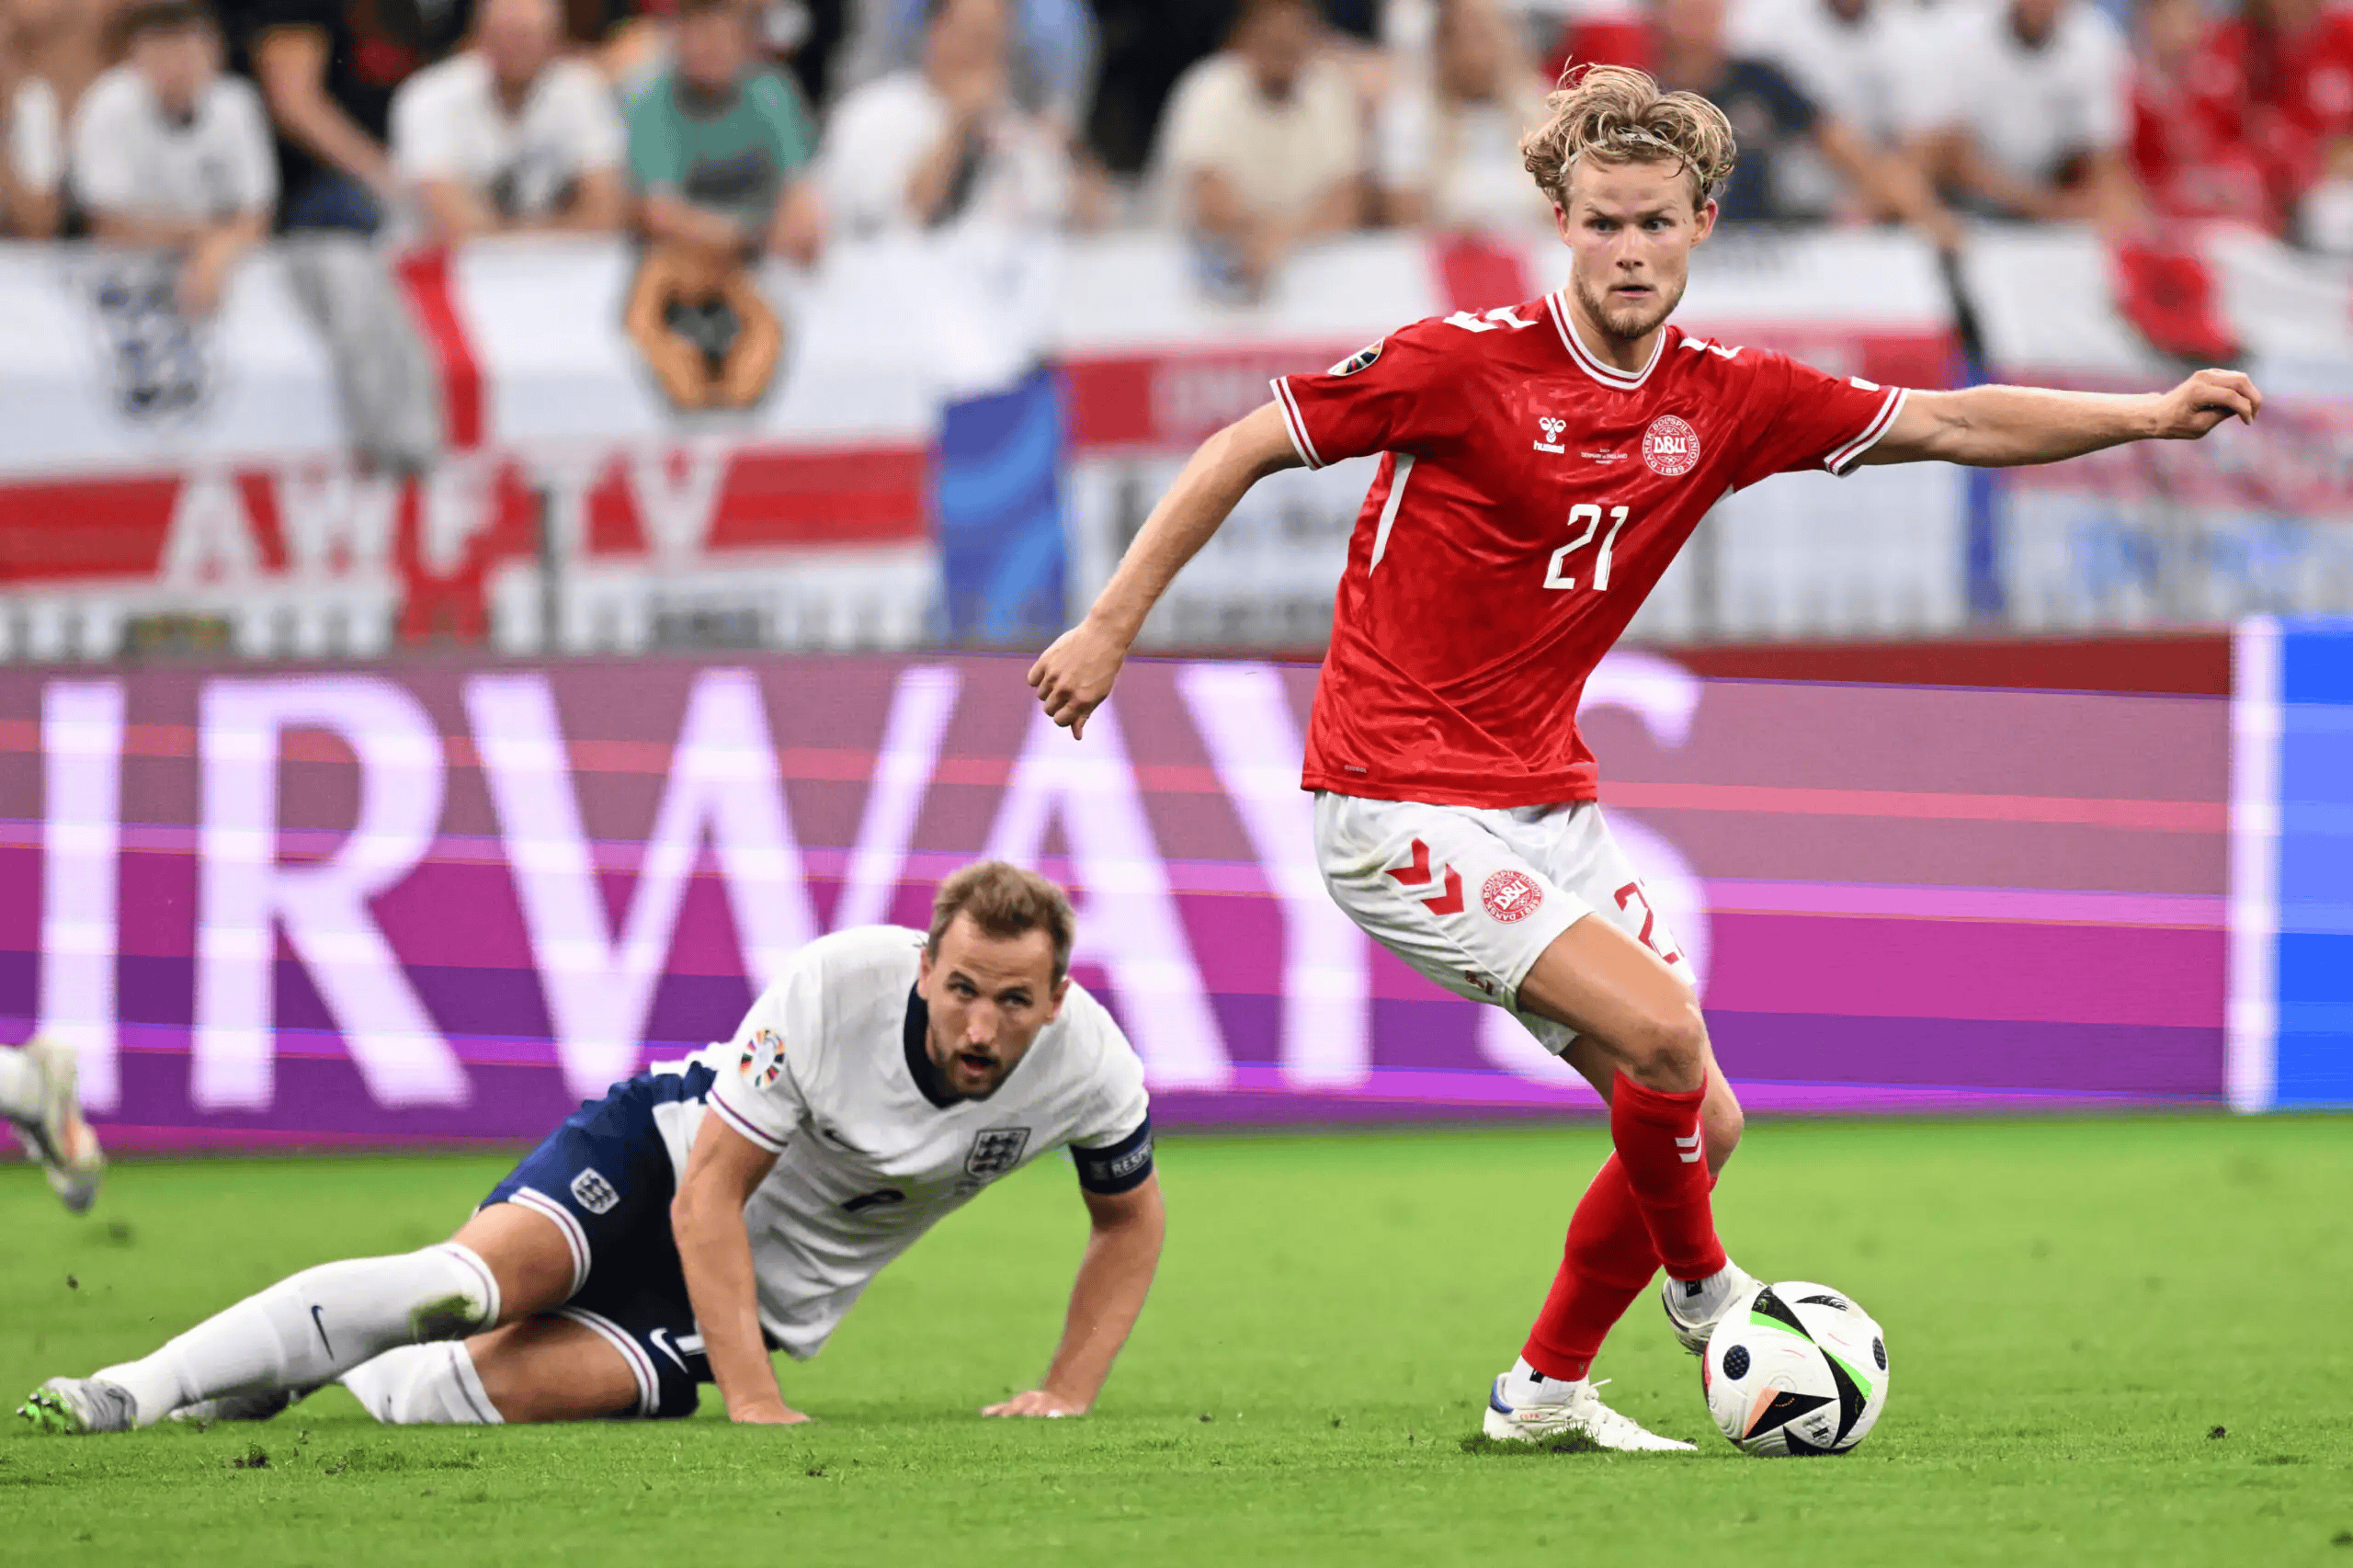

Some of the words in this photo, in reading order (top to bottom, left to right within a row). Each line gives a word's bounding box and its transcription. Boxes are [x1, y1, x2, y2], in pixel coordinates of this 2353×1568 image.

[1654, 436, 1688, 455] DBU
[1543, 504, 1630, 591] 21
[1493, 880, 1530, 910] DBU
